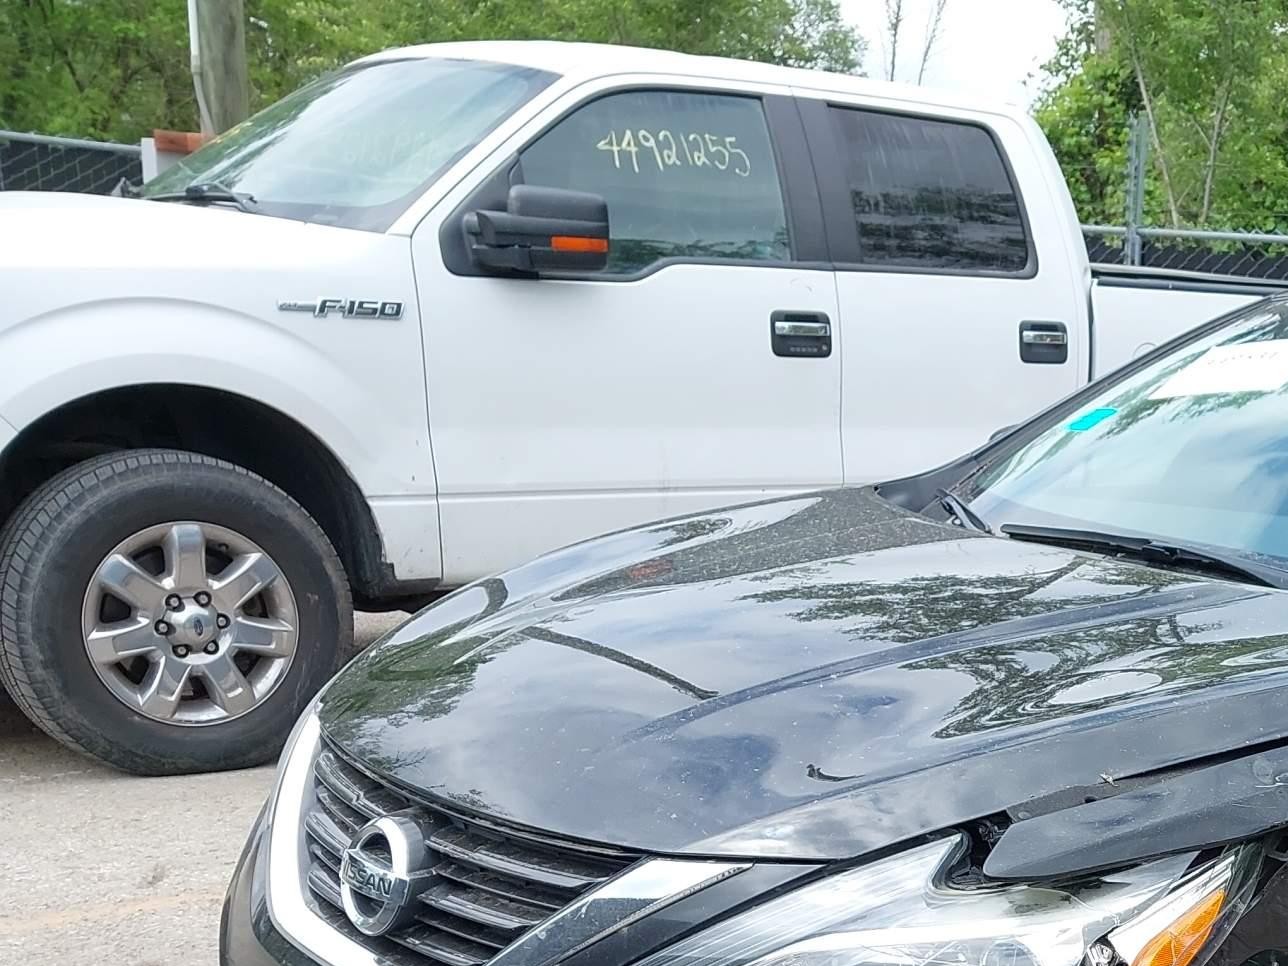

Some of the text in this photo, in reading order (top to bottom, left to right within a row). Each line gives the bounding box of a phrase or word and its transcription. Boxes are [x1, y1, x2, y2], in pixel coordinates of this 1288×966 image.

[595, 129, 751, 177] 44921255
[315, 299, 404, 320] F-150
[343, 859, 393, 896] ISSAN
